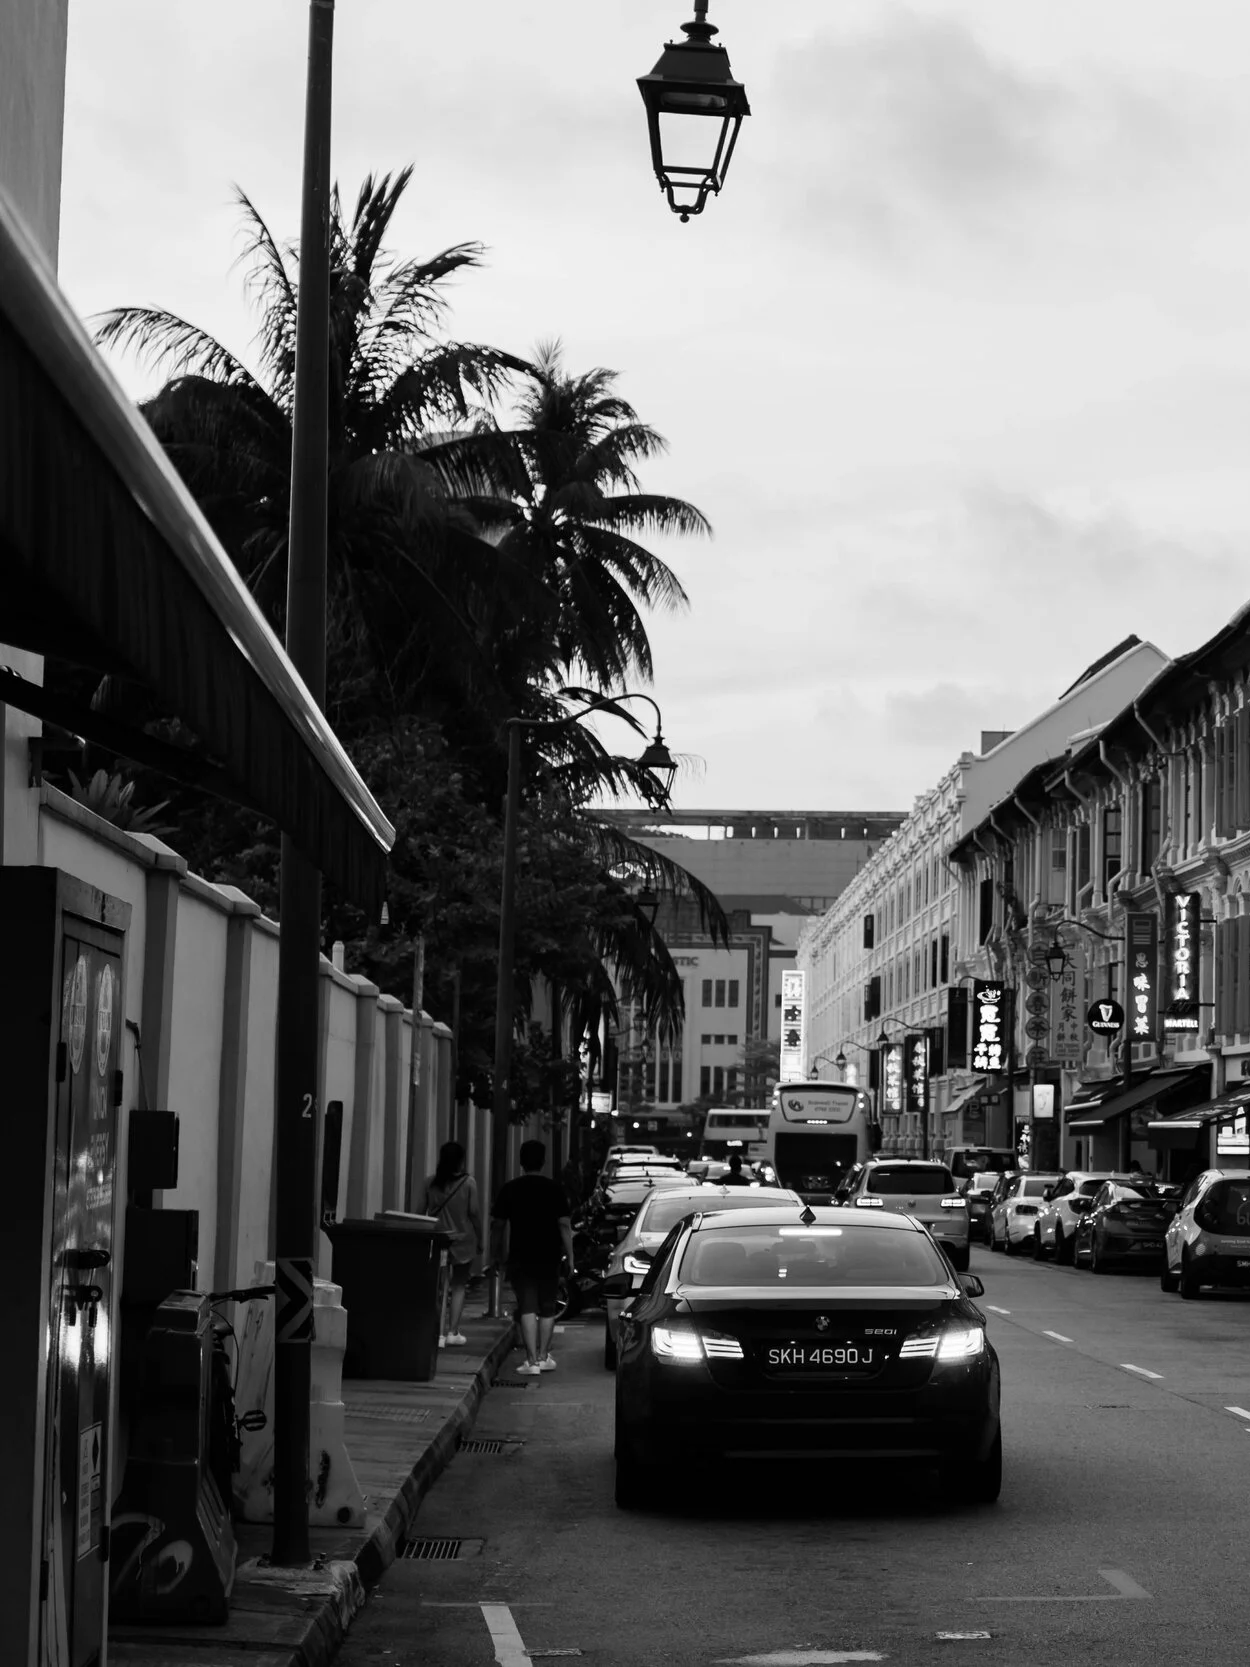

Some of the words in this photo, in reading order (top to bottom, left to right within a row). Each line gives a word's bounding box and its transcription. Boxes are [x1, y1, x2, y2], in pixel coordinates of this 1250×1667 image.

[1173, 894, 1192, 1001] VICTORIA
[1092, 1020, 1120, 1029] GUINNESS
[1164, 1018, 1199, 1029] MARTELL
[302, 1093, 312, 1118] 2
